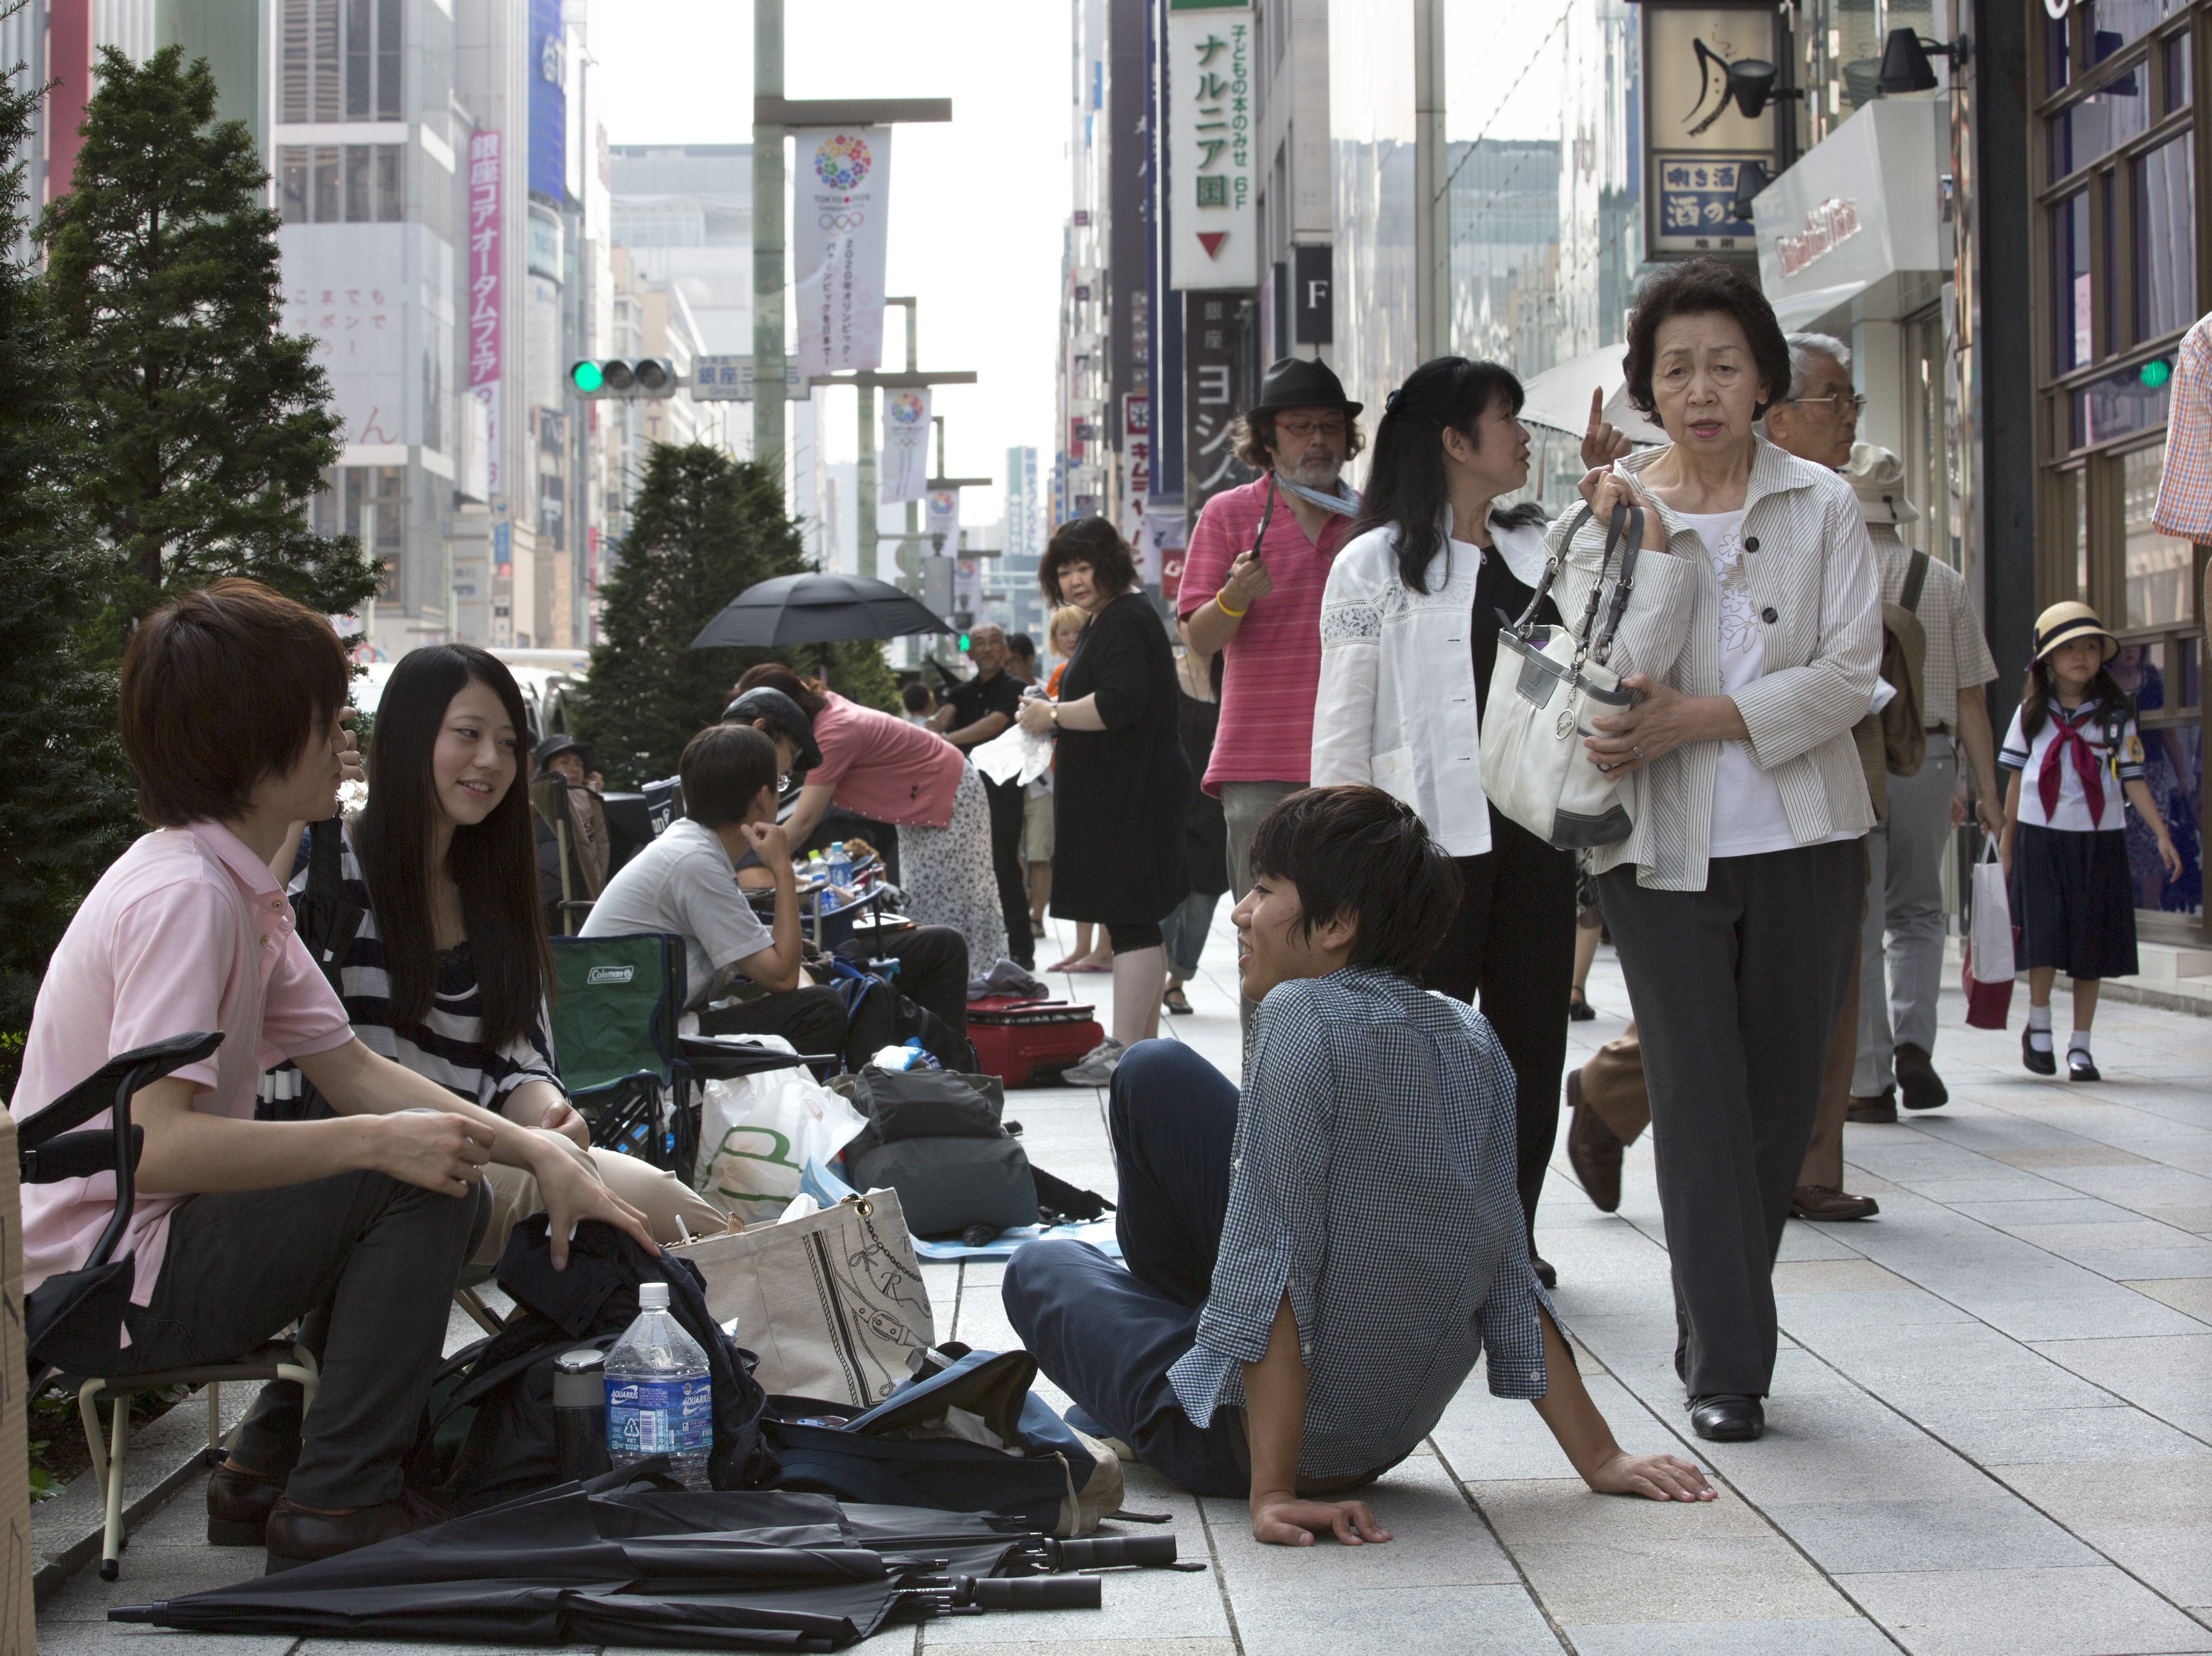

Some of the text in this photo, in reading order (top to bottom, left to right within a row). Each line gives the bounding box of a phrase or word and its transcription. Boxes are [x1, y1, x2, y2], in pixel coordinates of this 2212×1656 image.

[1195, 34, 1228, 208] ナルニア国
[1232, 25, 1248, 209] 子どもの本のみせ 6F
[471, 133, 498, 383] 銀座コアオータムフェア
[1308, 280, 1328, 309] F
[1195, 365, 1235, 517] ヨシノ
[591, 969, 623, 979] Coleman
[611, 1389, 638, 1400] AQUARIUS
[682, 1394, 711, 1407] AQUARIUS
